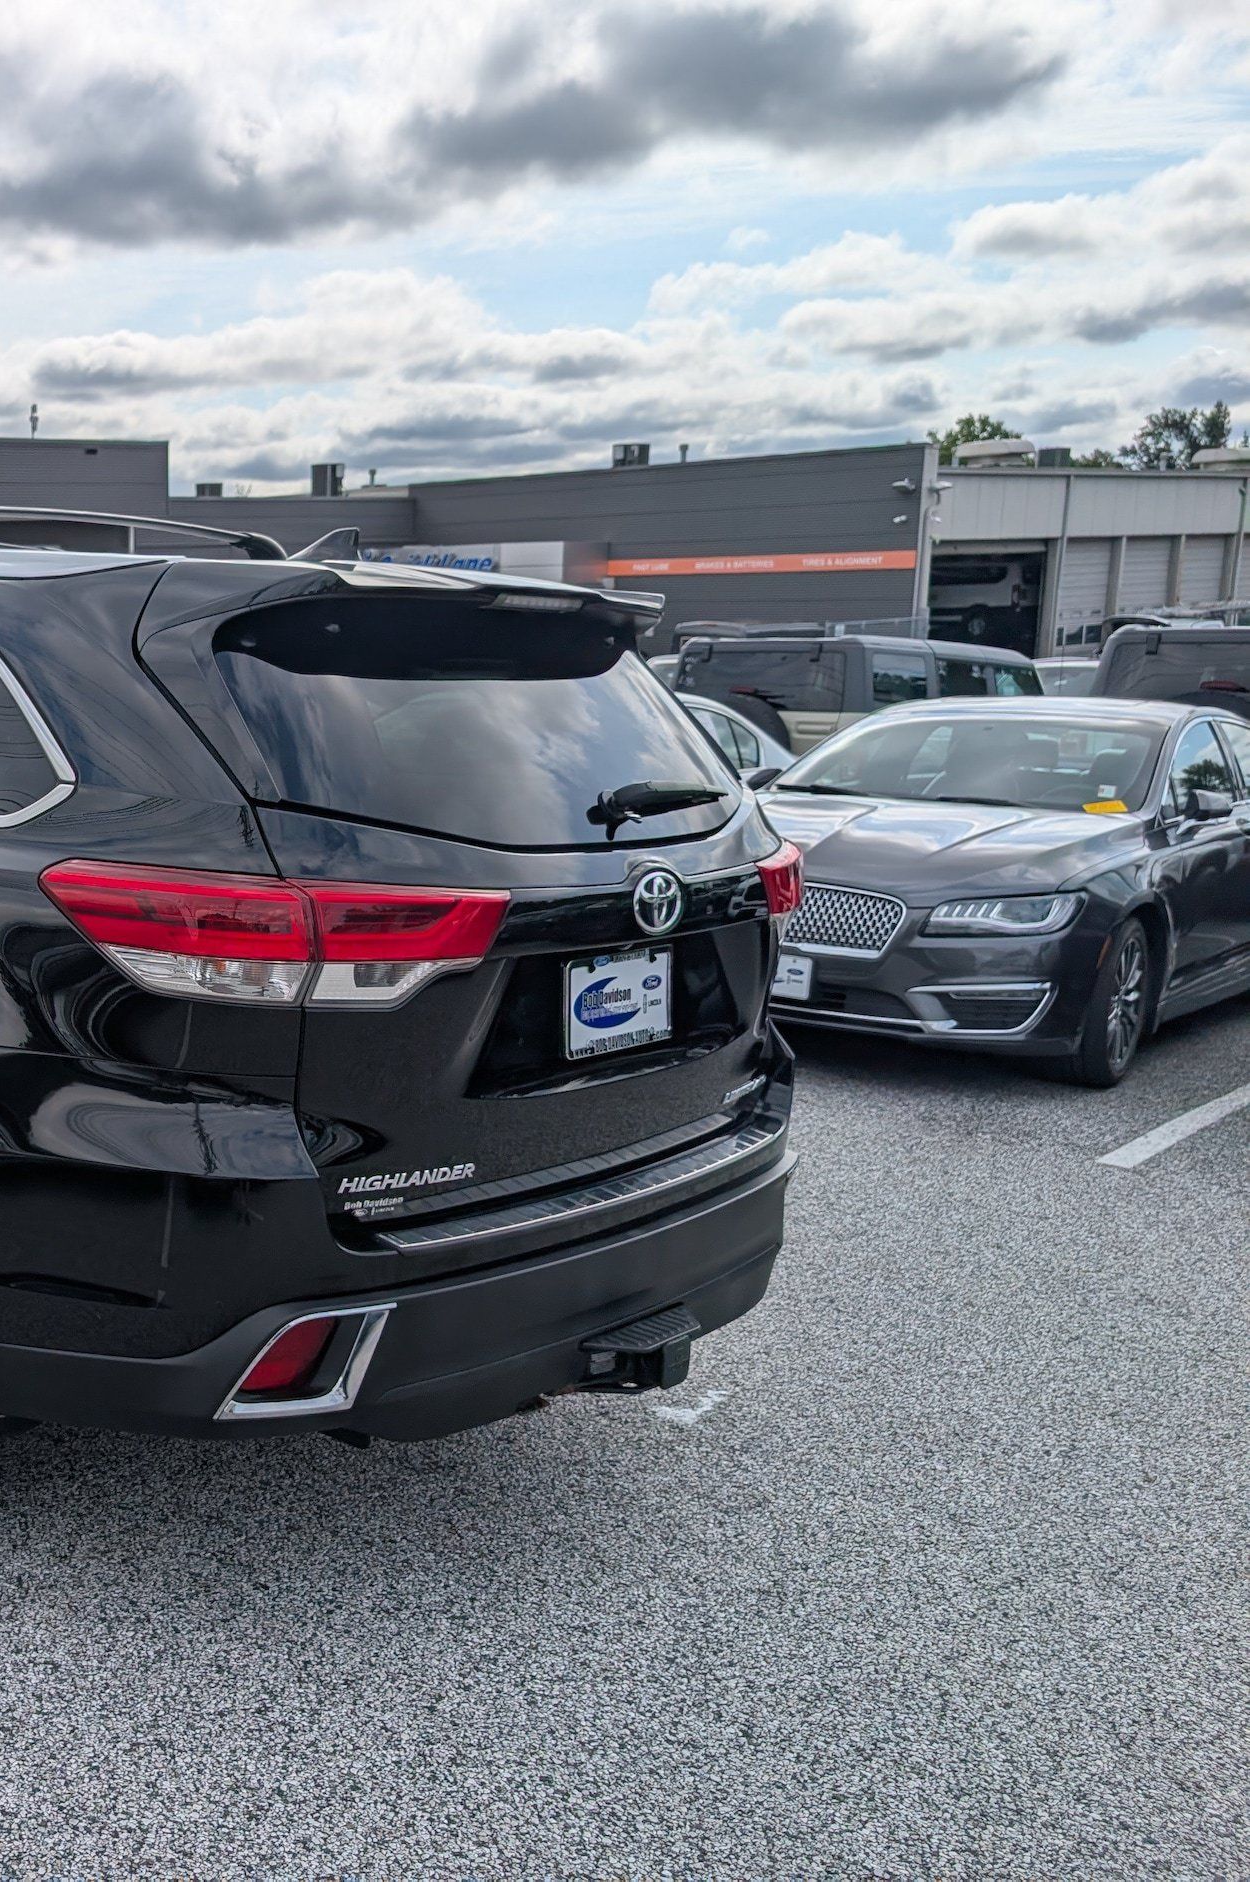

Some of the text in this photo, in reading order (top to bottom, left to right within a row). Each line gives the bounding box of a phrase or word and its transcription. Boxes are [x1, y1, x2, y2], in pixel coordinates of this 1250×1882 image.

[694, 561, 725, 570] BRAKES
[732, 559, 775, 569] BATTERIES
[802, 558, 825, 567] TIRES
[834, 556, 884, 567] ALIGNMENT
[600, 988, 632, 1006] Davidson
[337, 1163, 476, 1194] HIGHLANDER
[344, 1196, 404, 1211] Bob Davidson
